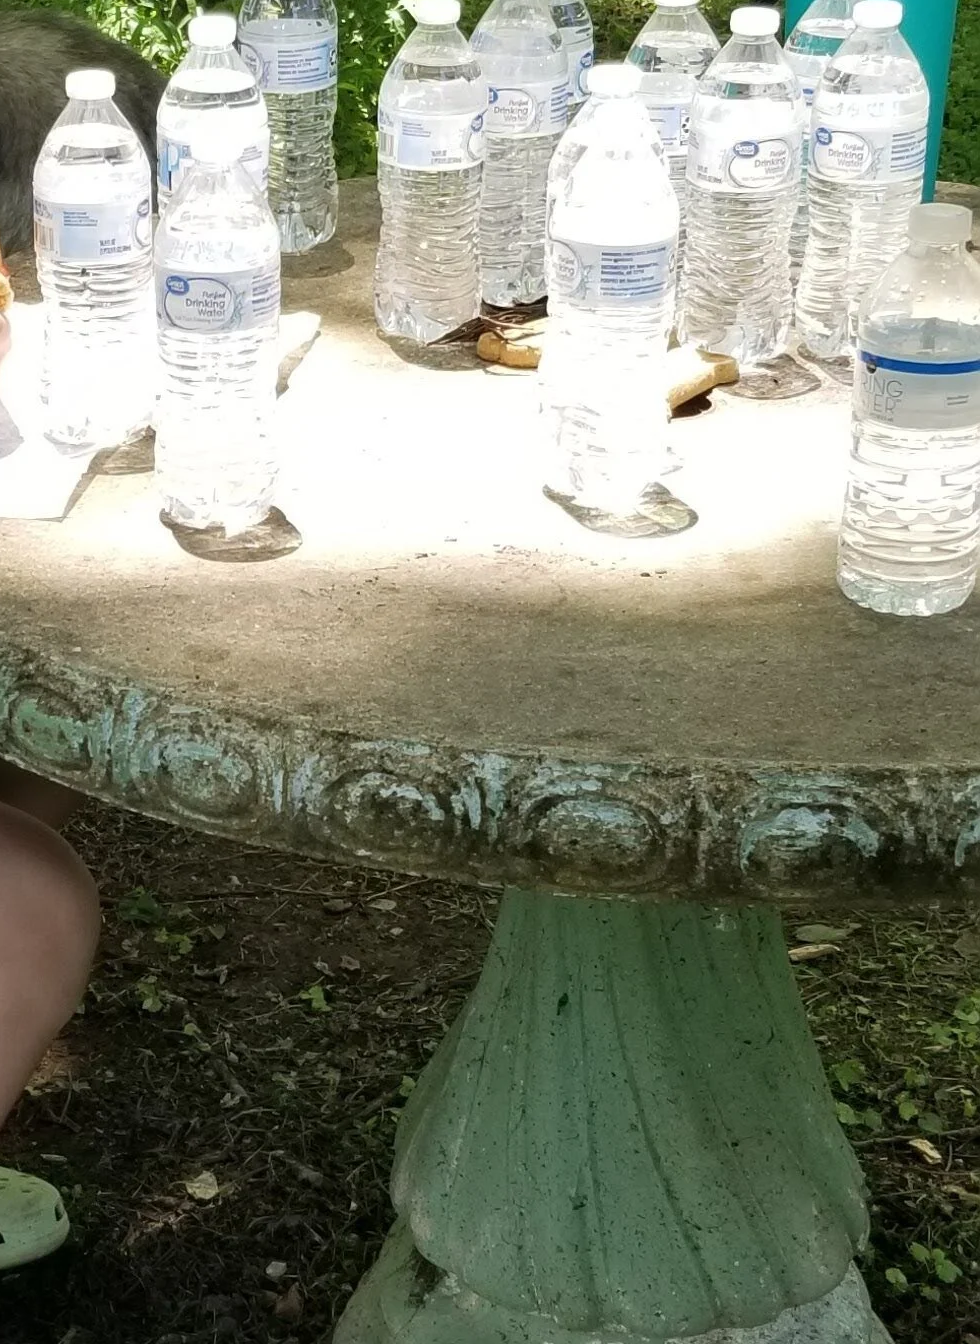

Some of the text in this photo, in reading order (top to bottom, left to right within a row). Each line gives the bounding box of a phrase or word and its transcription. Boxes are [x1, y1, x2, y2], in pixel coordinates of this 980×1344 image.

[494, 105, 529, 116] Drinking
[504, 114, 528, 122] Water
[828, 148, 864, 160] Drinking
[754, 157, 787, 168] Drinking
[837, 158, 863, 168] Water
[185, 298, 226, 310] Drinking
[198, 308, 226, 317] Water
